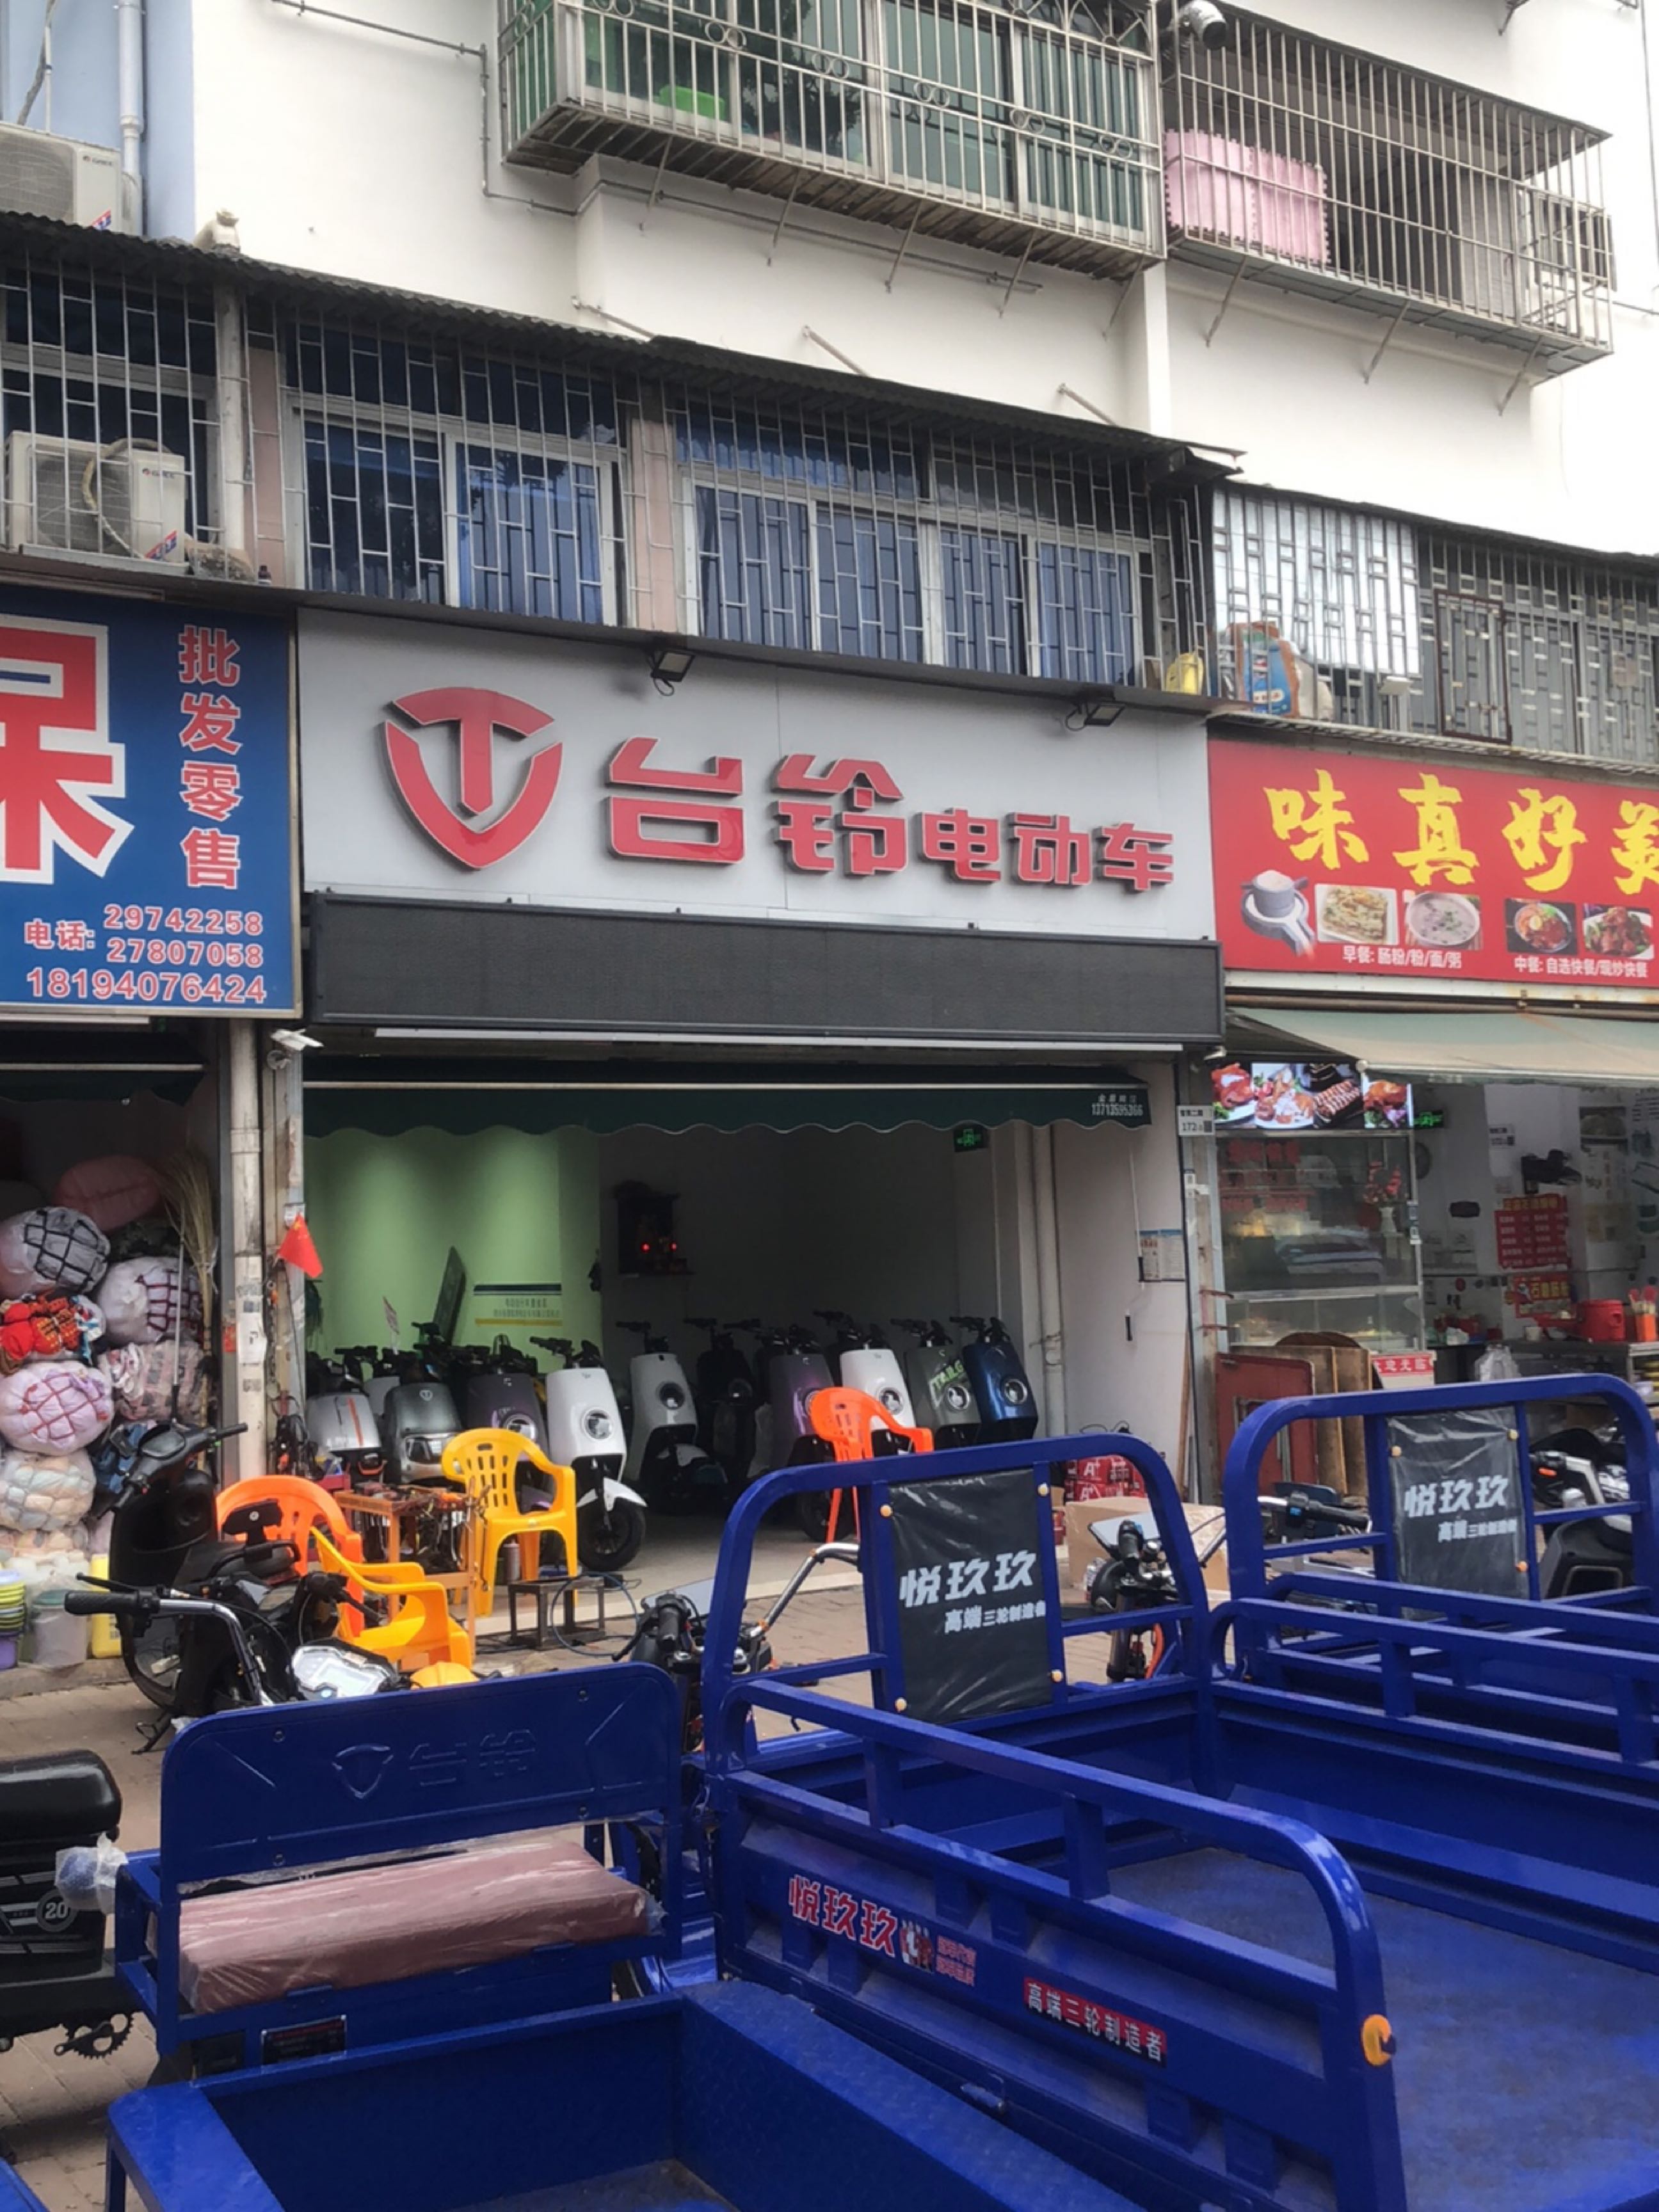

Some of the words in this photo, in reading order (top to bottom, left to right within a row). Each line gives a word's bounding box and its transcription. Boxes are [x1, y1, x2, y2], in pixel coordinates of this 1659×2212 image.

[179, 625, 242, 889] 批发零售
[607, 737, 1174, 892] 台铃电动车
[104, 904, 263, 936] 29742258
[106, 938, 264, 967] 27807058
[27, 967, 266, 1004] 18194076424
[1404, 1475, 1509, 1519] 悦玖玖
[899, 1549, 1038, 1608] 悦玖玖
[45, 1902, 68, 1919] 20
[788, 1873, 898, 1958] 悦玖玖
[1027, 1982, 1162, 2062] 高端三轮制造者
